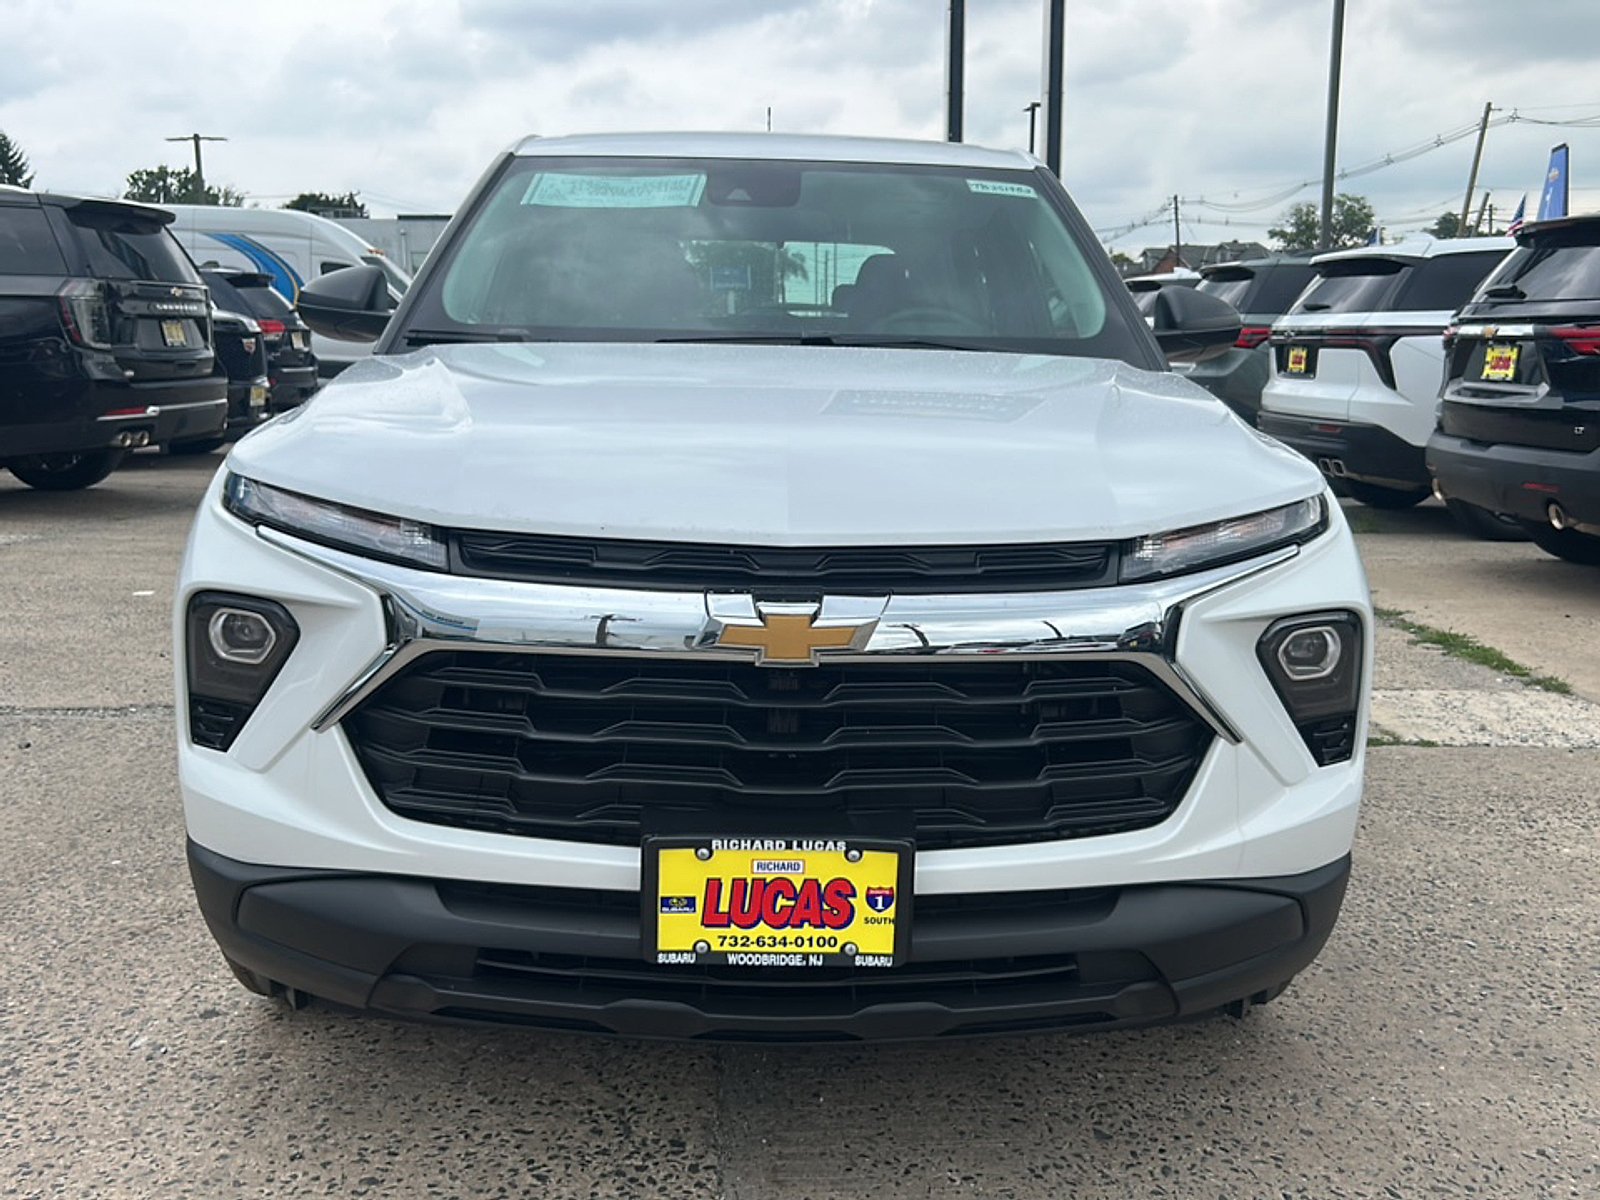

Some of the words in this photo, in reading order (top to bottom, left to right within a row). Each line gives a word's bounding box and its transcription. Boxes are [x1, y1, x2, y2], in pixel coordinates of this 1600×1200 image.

[711, 838, 787, 851] RICHARD
[792, 839, 847, 852] LUCAS
[756, 861, 801, 873] RICHARD
[700, 877, 857, 929] LUCAS
[874, 895, 885, 910] 1
[864, 916, 895, 925] SOUTH
[717, 935, 839, 948] 732-634-0100
[657, 953, 696, 964] SUBARU
[808, 954, 823, 967] NJ
[854, 955, 893, 968] SUBARU
